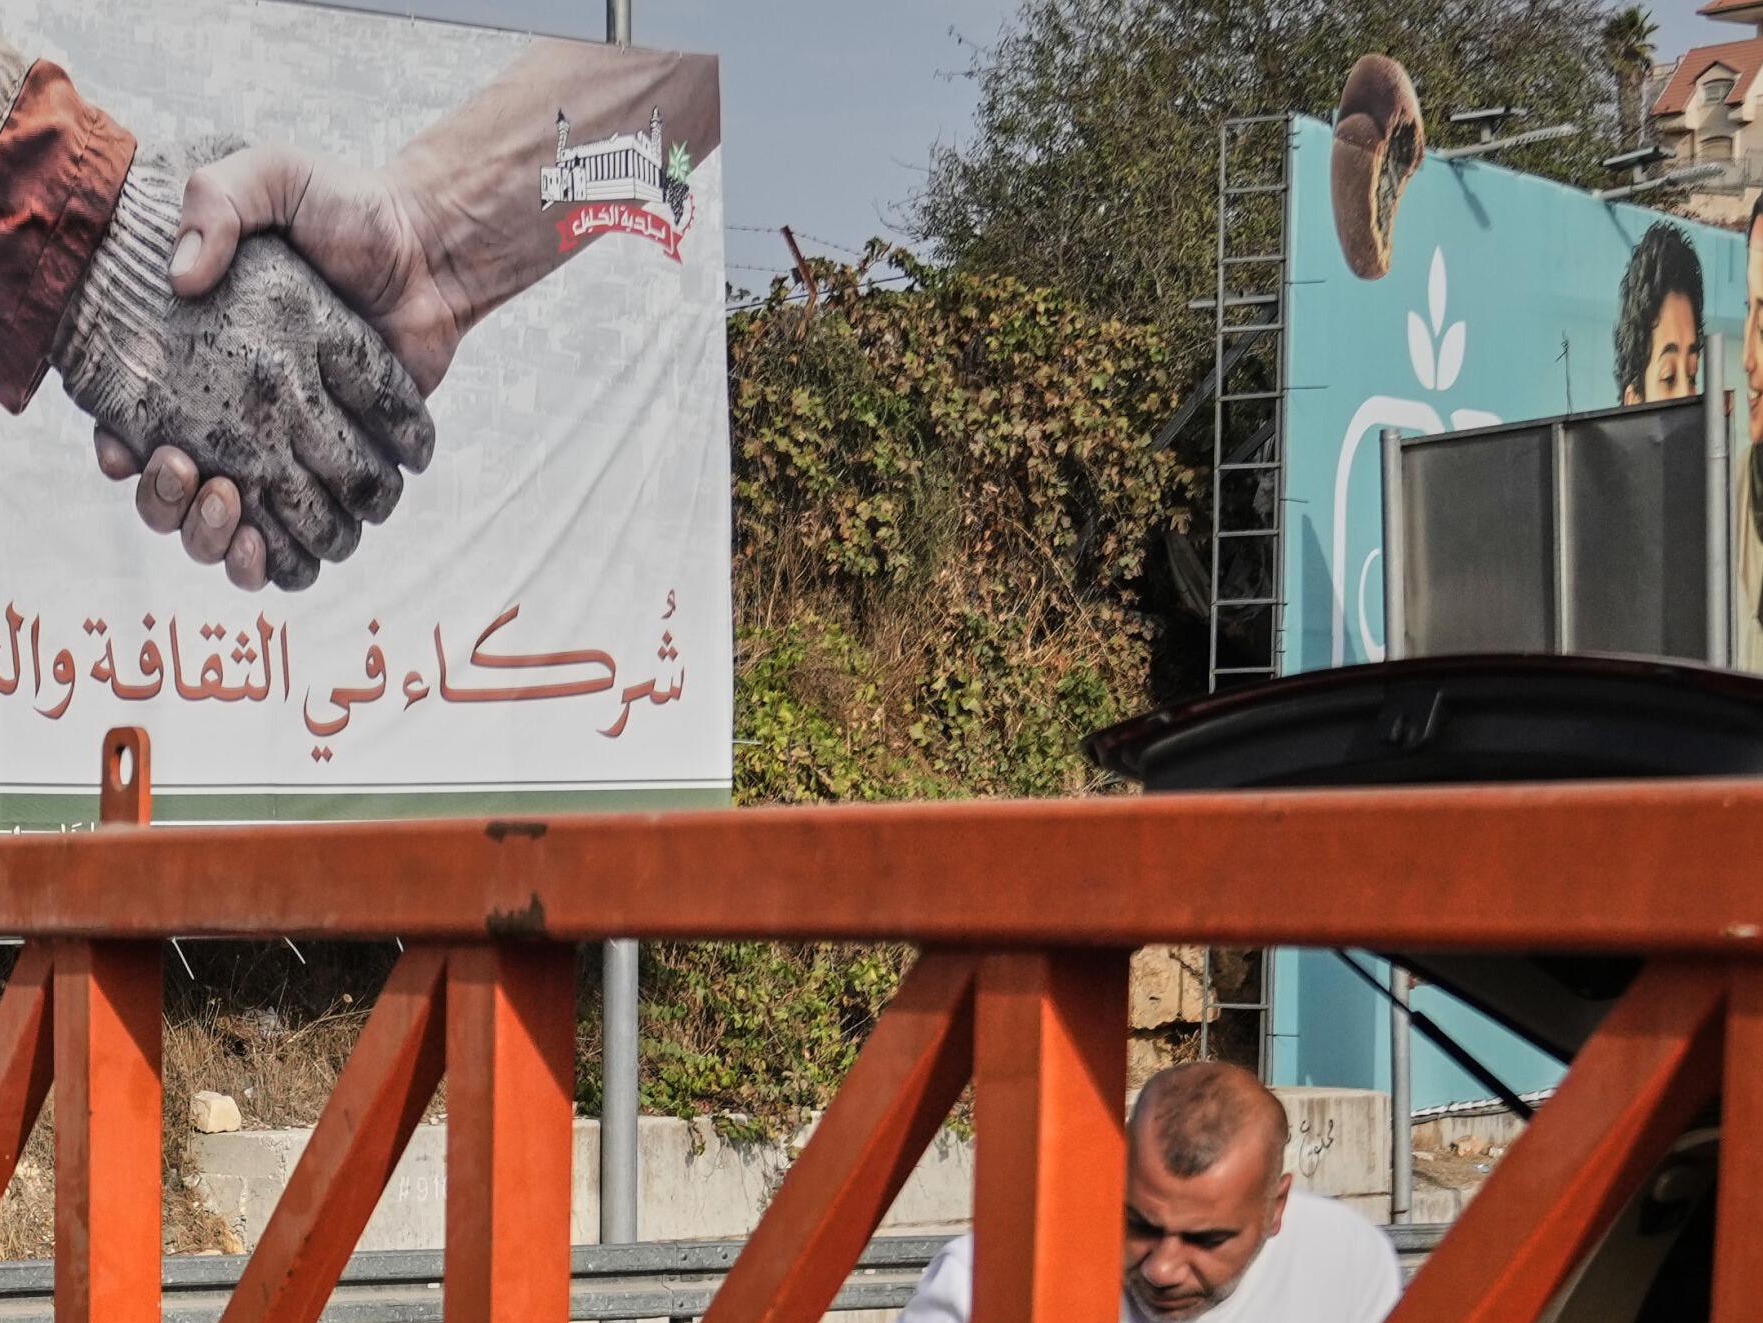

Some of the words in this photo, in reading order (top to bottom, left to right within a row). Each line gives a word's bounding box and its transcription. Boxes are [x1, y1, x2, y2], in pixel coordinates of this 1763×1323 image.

[572, 203, 620, 236] الخليل
[620, 204, 666, 240] بلدية
[83, 610, 292, 706] الثقافة
[303, 617, 388, 764] في
